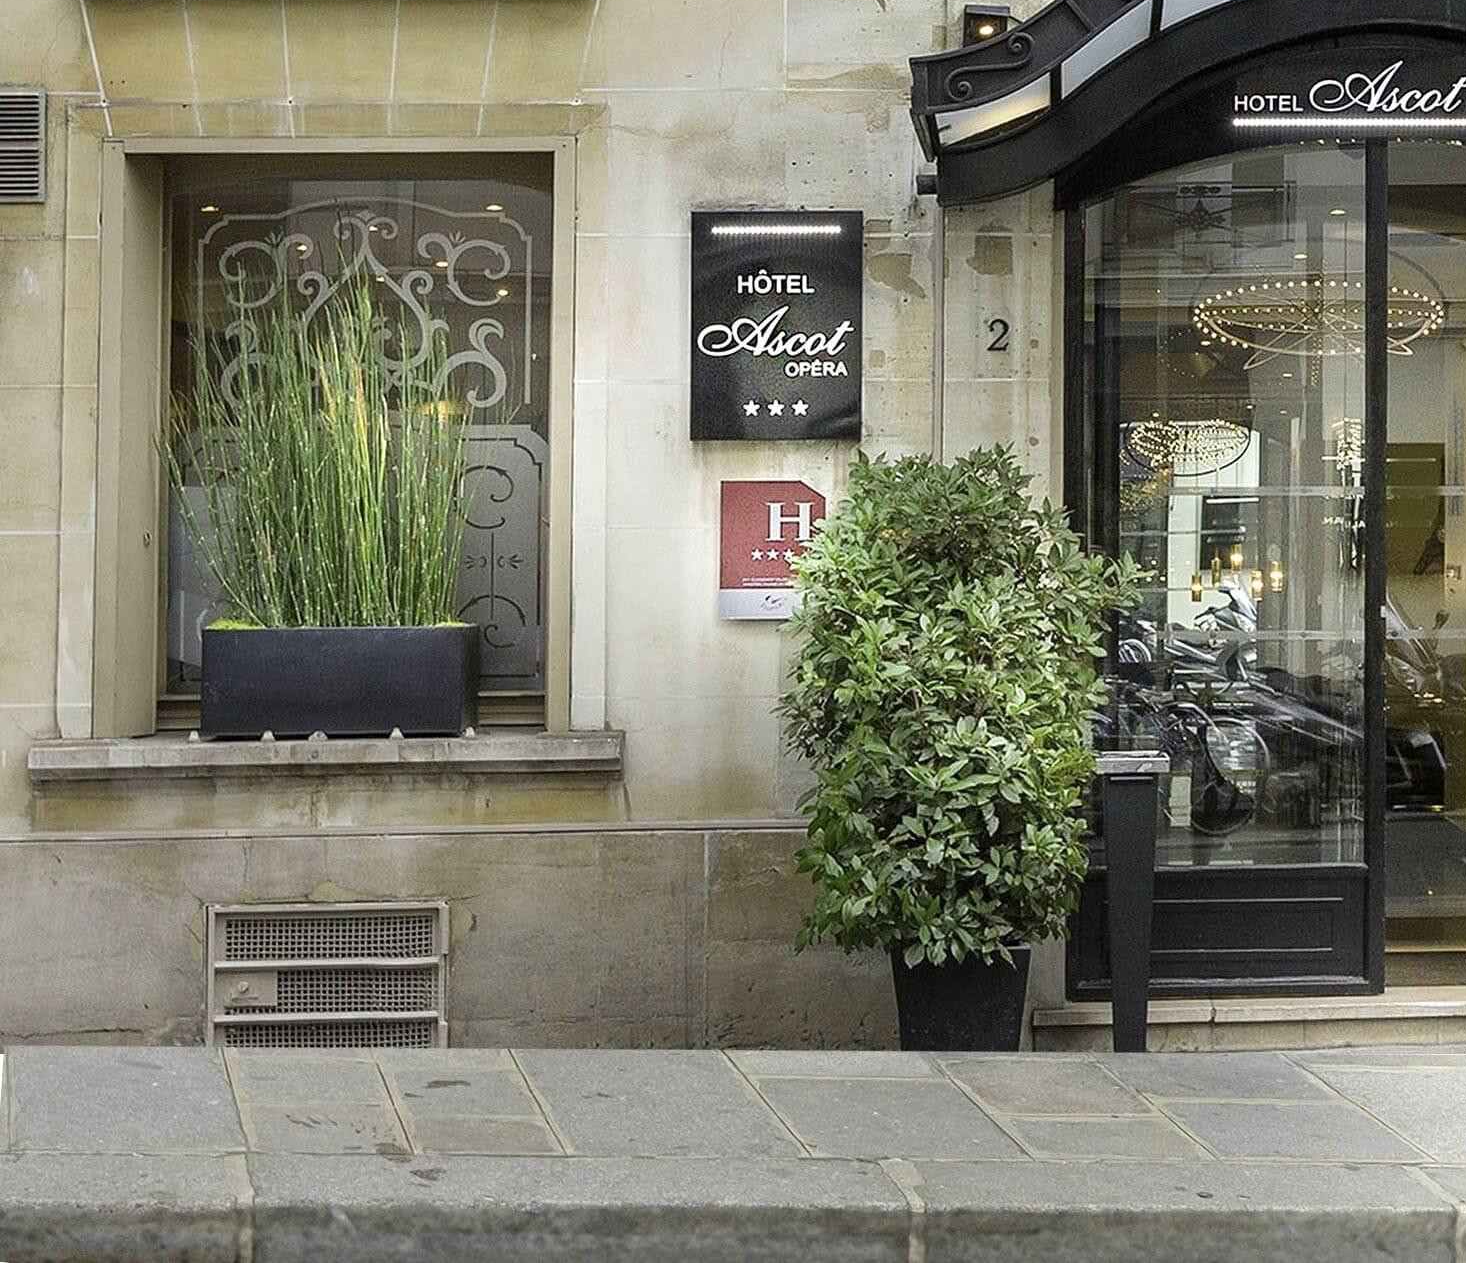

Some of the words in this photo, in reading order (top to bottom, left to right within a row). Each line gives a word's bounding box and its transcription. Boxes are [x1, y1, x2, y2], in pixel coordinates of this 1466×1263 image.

[1234, 95, 1304, 113] HOTEL
[736, 269, 815, 295] HÔTEL
[697, 305, 854, 357] Ascot
[987, 318, 1010, 351] 2
[784, 357, 848, 378] OPÉRA
[765, 501, 815, 542] H
